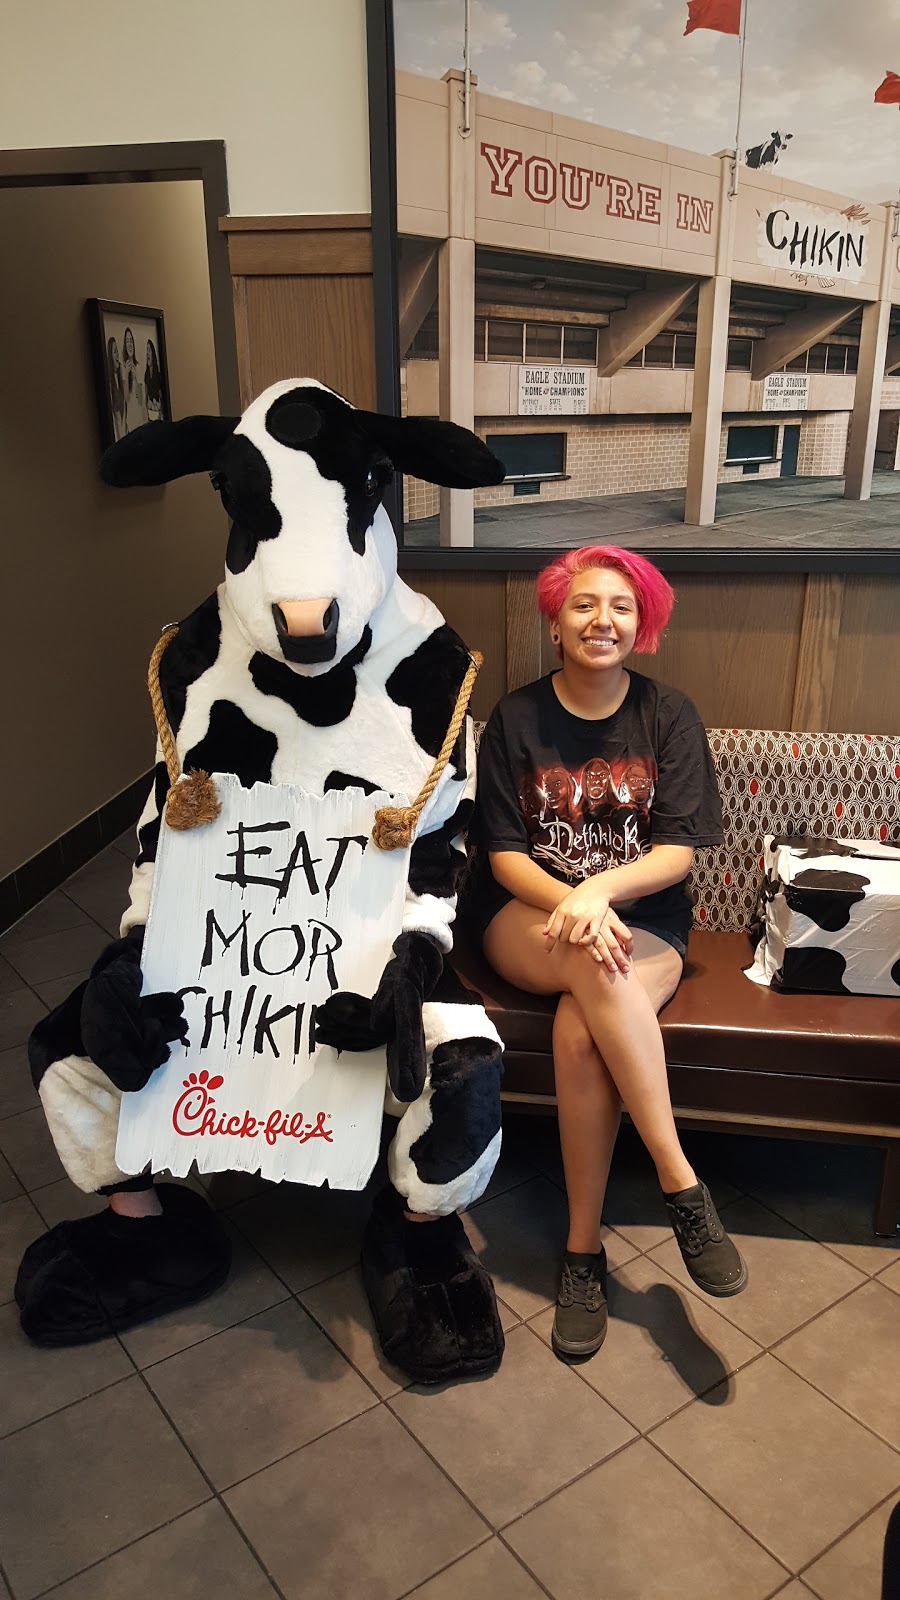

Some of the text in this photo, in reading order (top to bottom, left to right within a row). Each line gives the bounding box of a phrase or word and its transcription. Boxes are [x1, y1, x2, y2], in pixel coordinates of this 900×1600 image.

[480, 142, 662, 225] YOU'RE
[676, 193, 714, 235] IN
[765, 209, 864, 272] CHIKIN
[525, 370, 586, 385] EAGLE STADIUM
[768, 377, 784, 388] EAGLE
[215, 821, 369, 914] EAT
[198, 909, 343, 993] MOR
